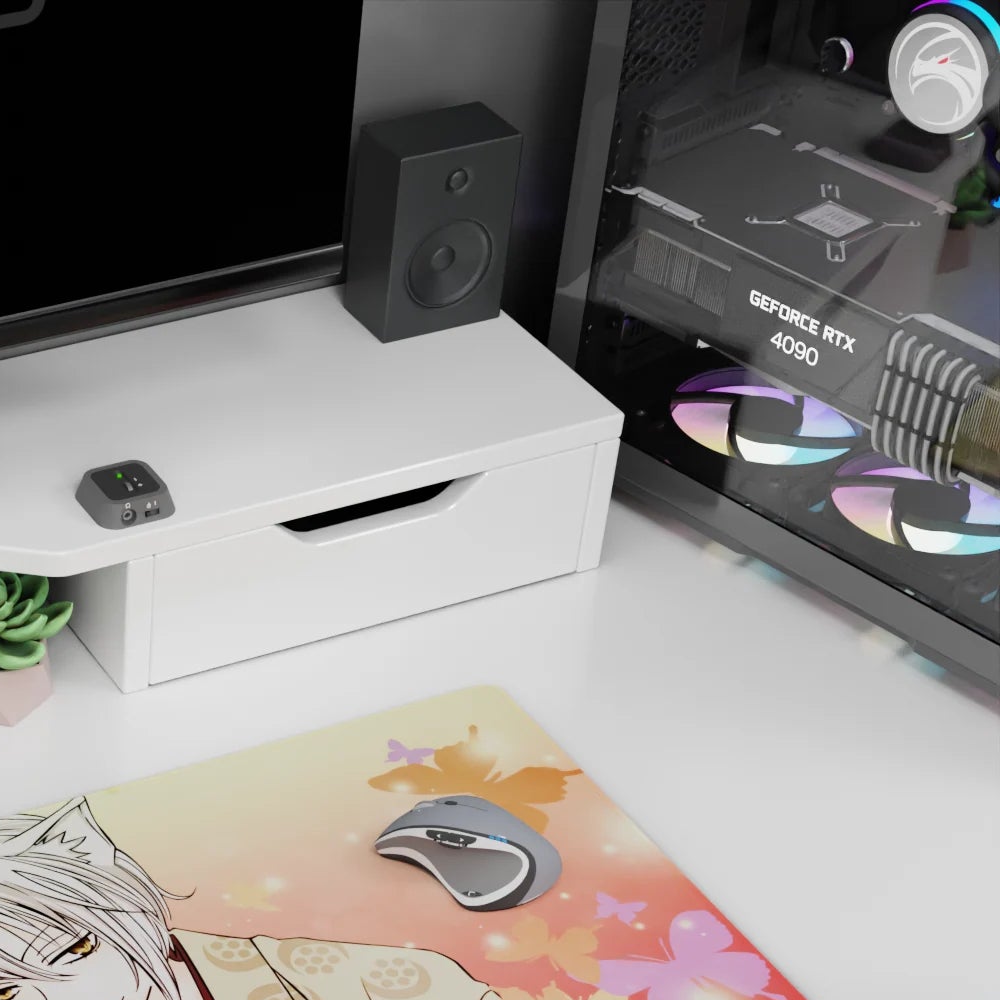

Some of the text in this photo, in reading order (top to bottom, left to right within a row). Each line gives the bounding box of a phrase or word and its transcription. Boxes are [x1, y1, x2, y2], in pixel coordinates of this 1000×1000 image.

[749, 289, 856, 354] GEFORCE RTX
[770, 331, 819, 367] 4090
